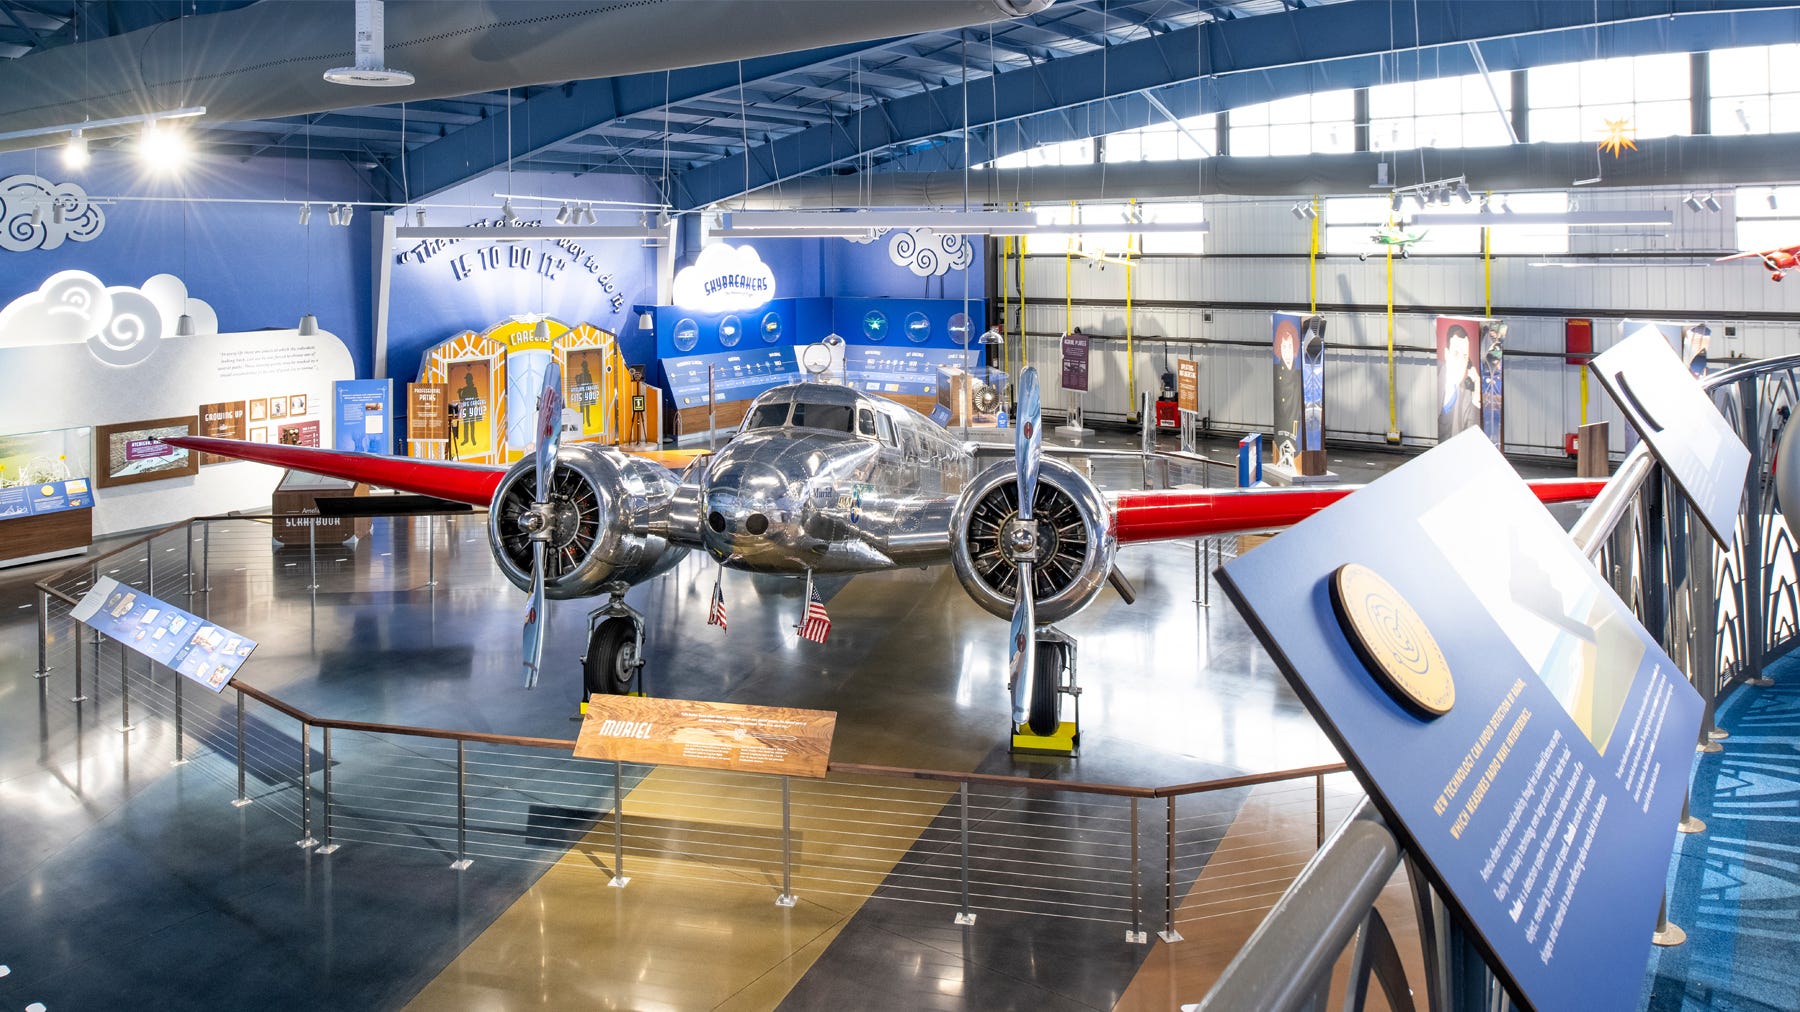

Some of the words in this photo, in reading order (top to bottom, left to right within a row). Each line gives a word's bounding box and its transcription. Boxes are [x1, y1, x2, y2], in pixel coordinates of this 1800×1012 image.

[452, 254, 472, 280] IS
[479, 247, 500, 269] TO
[511, 245, 532, 269] DO
[558, 237, 585, 261] way
[586, 254, 600, 273] to
[600, 273, 614, 291] do
[612, 294, 625, 313] it,
[704, 274, 768, 296] SKYBREAKERS
[584, 391, 599, 400] YOU?
[234, 410, 243, 418] UP
[469, 406, 487, 417] YOU?
[285, 517, 341, 527] SCRABOOK
[600, 719, 654, 740] MURIEL
[1432, 793, 1448, 817] NEW
[1443, 753, 1474, 799] TECHNOLOGY
[1469, 740, 1483, 759] CAN
[1478, 724, 1494, 747] AVOID
[1489, 698, 1511, 730] DETECTION
[1448, 808, 1470, 840] WHICH
[1465, 775, 1490, 814] MEASURES
[1484, 757, 1501, 782] RADIO
[1495, 741, 1510, 763] WAVE
